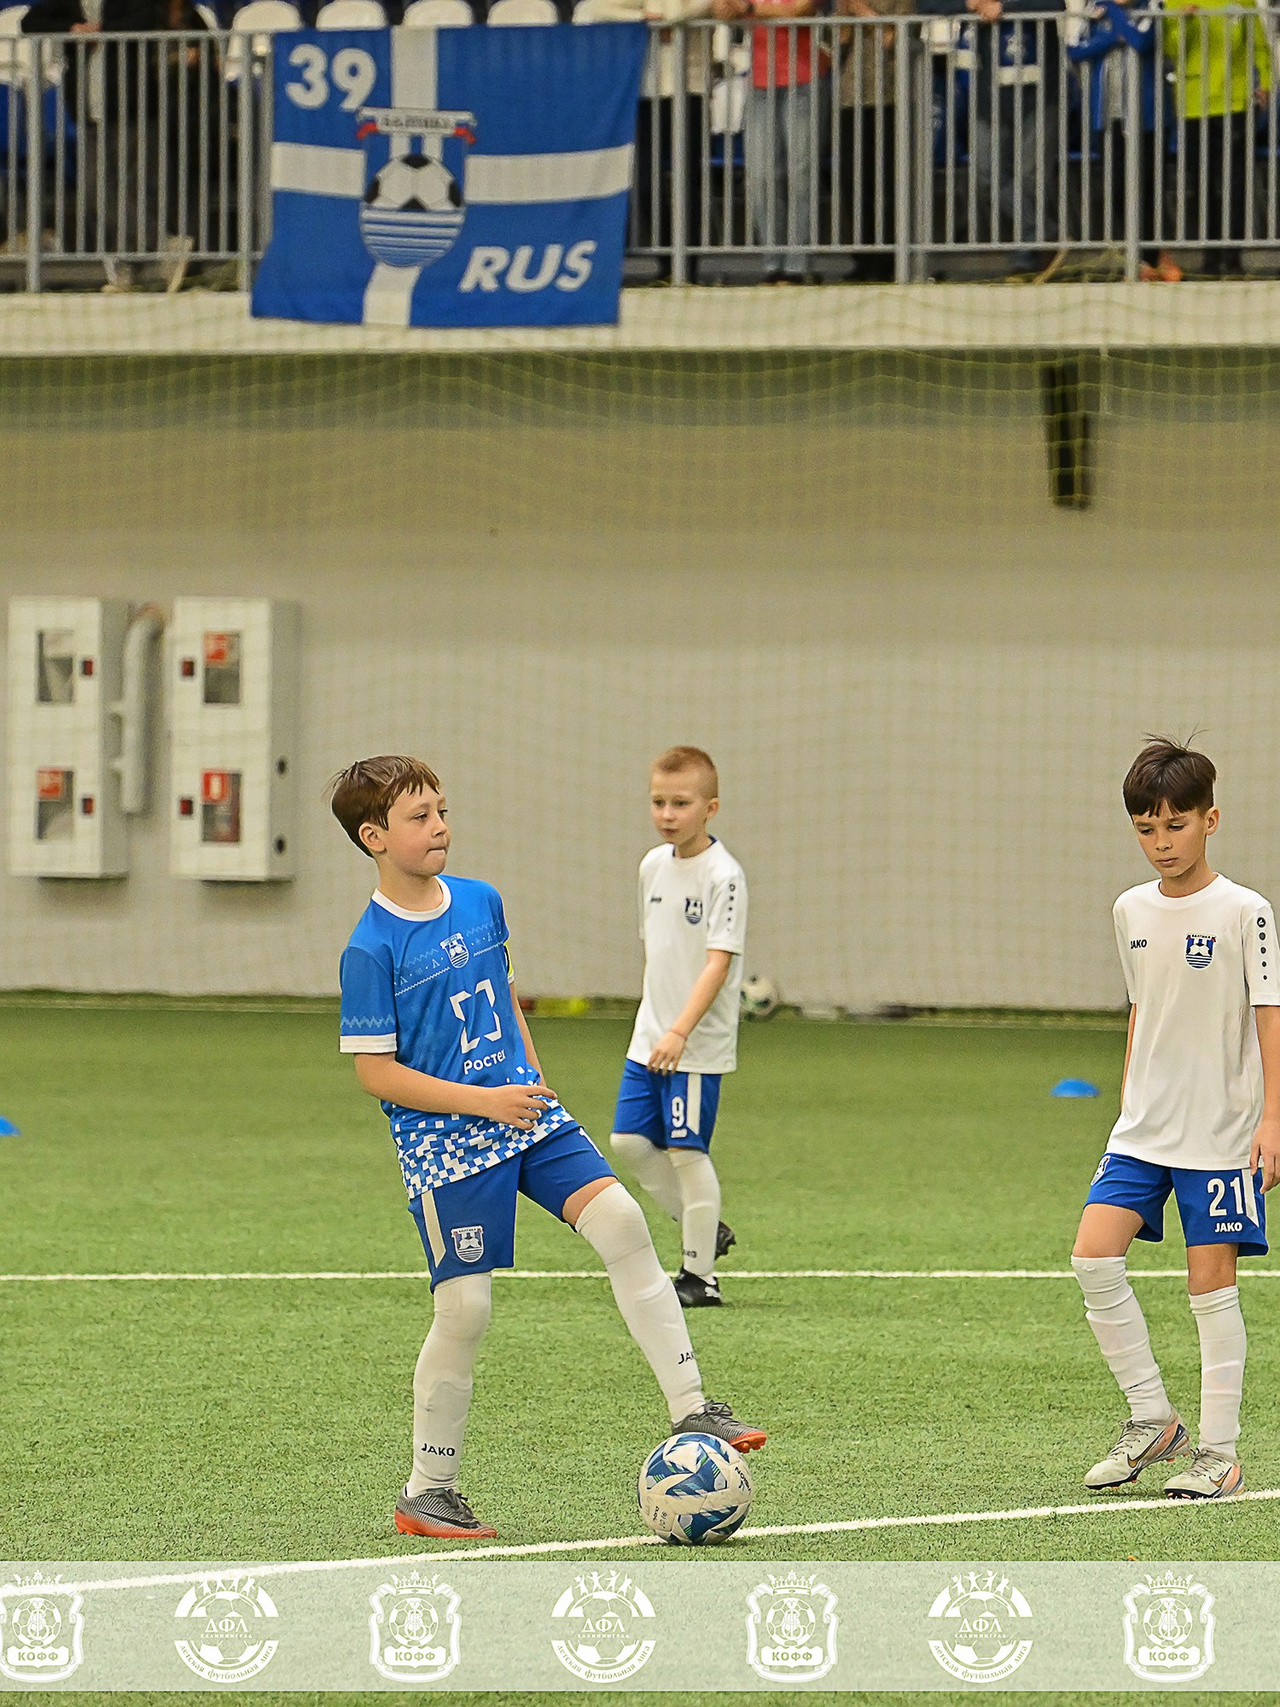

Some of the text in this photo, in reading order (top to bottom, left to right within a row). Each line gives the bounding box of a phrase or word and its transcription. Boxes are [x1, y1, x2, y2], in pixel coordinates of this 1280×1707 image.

[286, 44, 377, 111] 39
[458, 240, 598, 293] RUS
[671, 1096, 685, 1128] 9
[1207, 1177, 1244, 1217] 21
[1214, 1222, 1243, 1233] JAKO
[421, 1443, 456, 1457] JAKO
